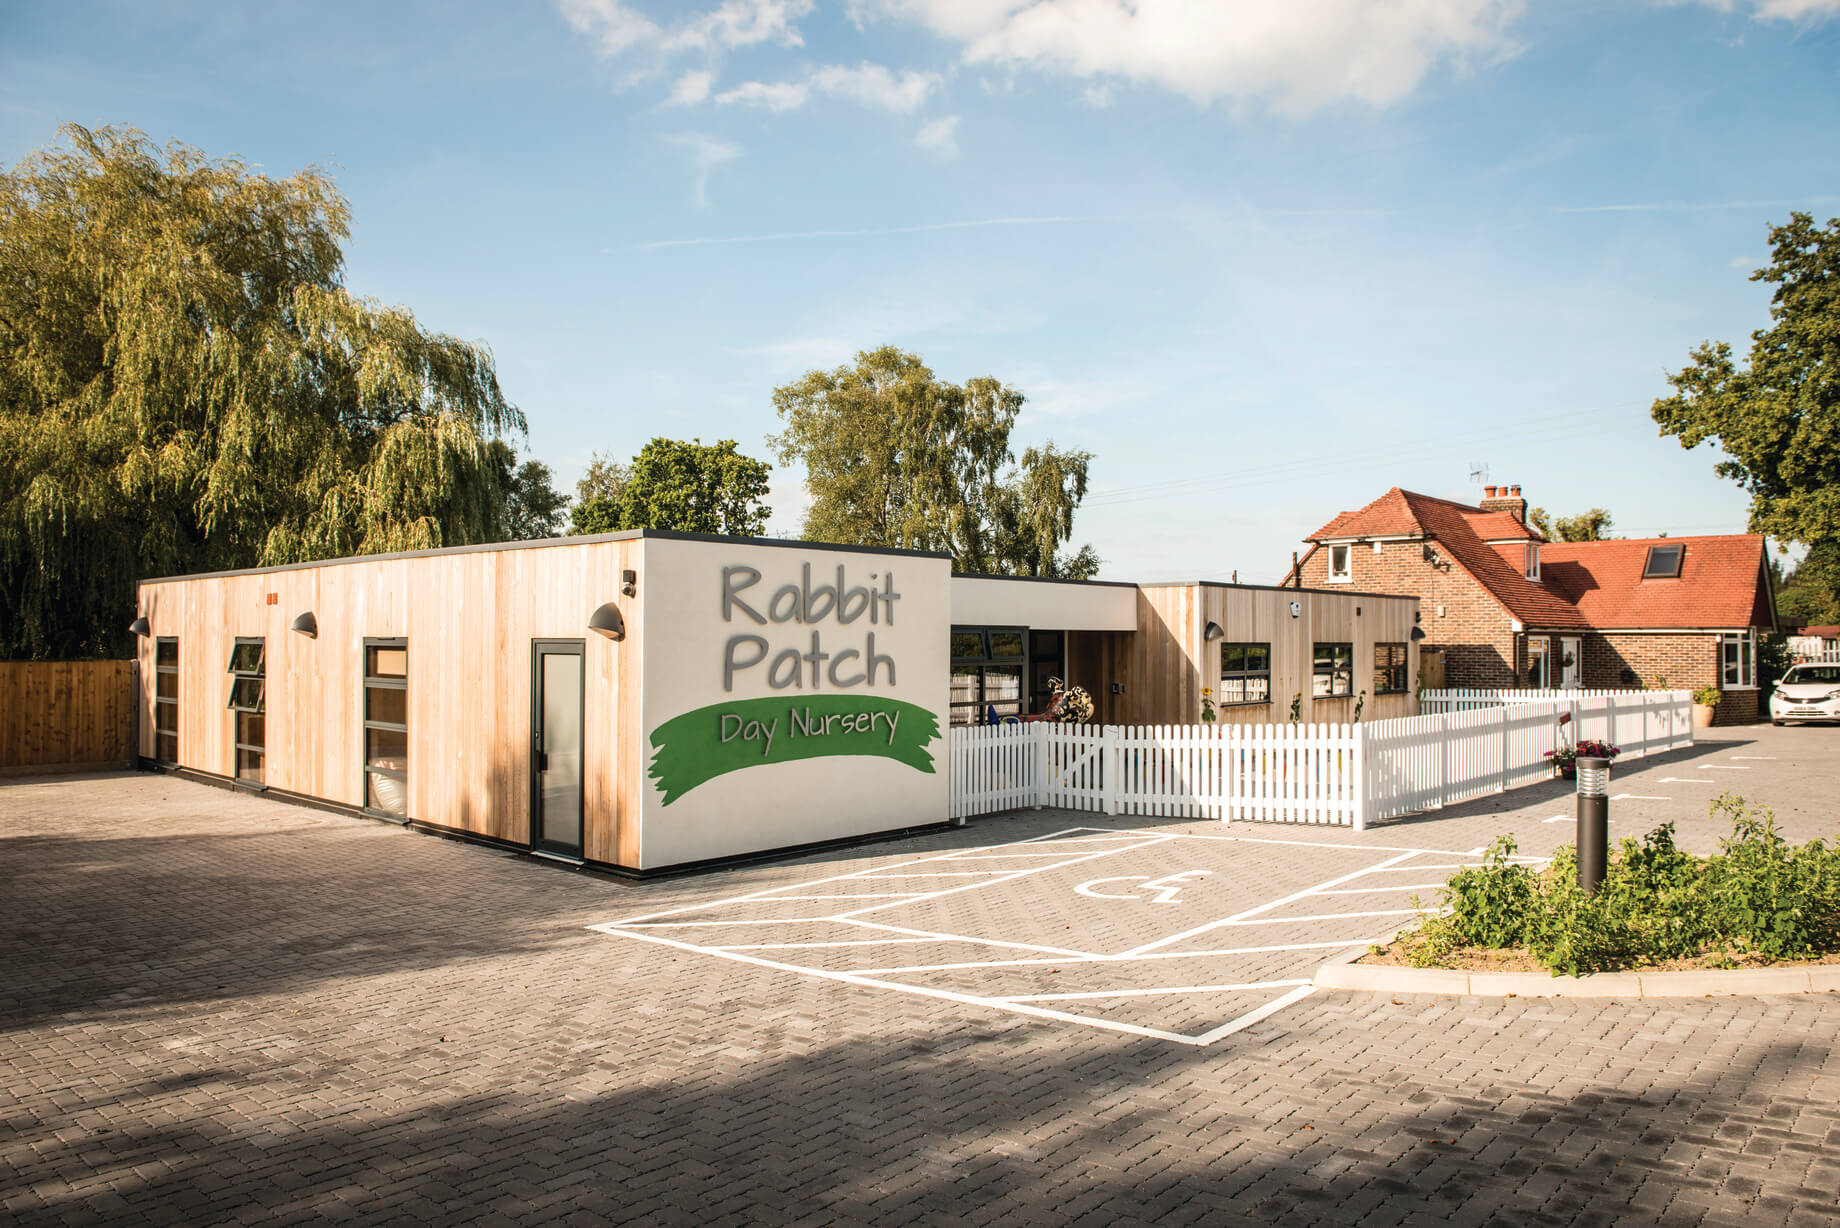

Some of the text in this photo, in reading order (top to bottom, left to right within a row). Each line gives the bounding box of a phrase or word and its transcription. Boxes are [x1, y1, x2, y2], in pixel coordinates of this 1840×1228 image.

[722, 563, 901, 626] Rabbit
[723, 630, 897, 692] Patch
[720, 706, 900, 757] Day Nursery
